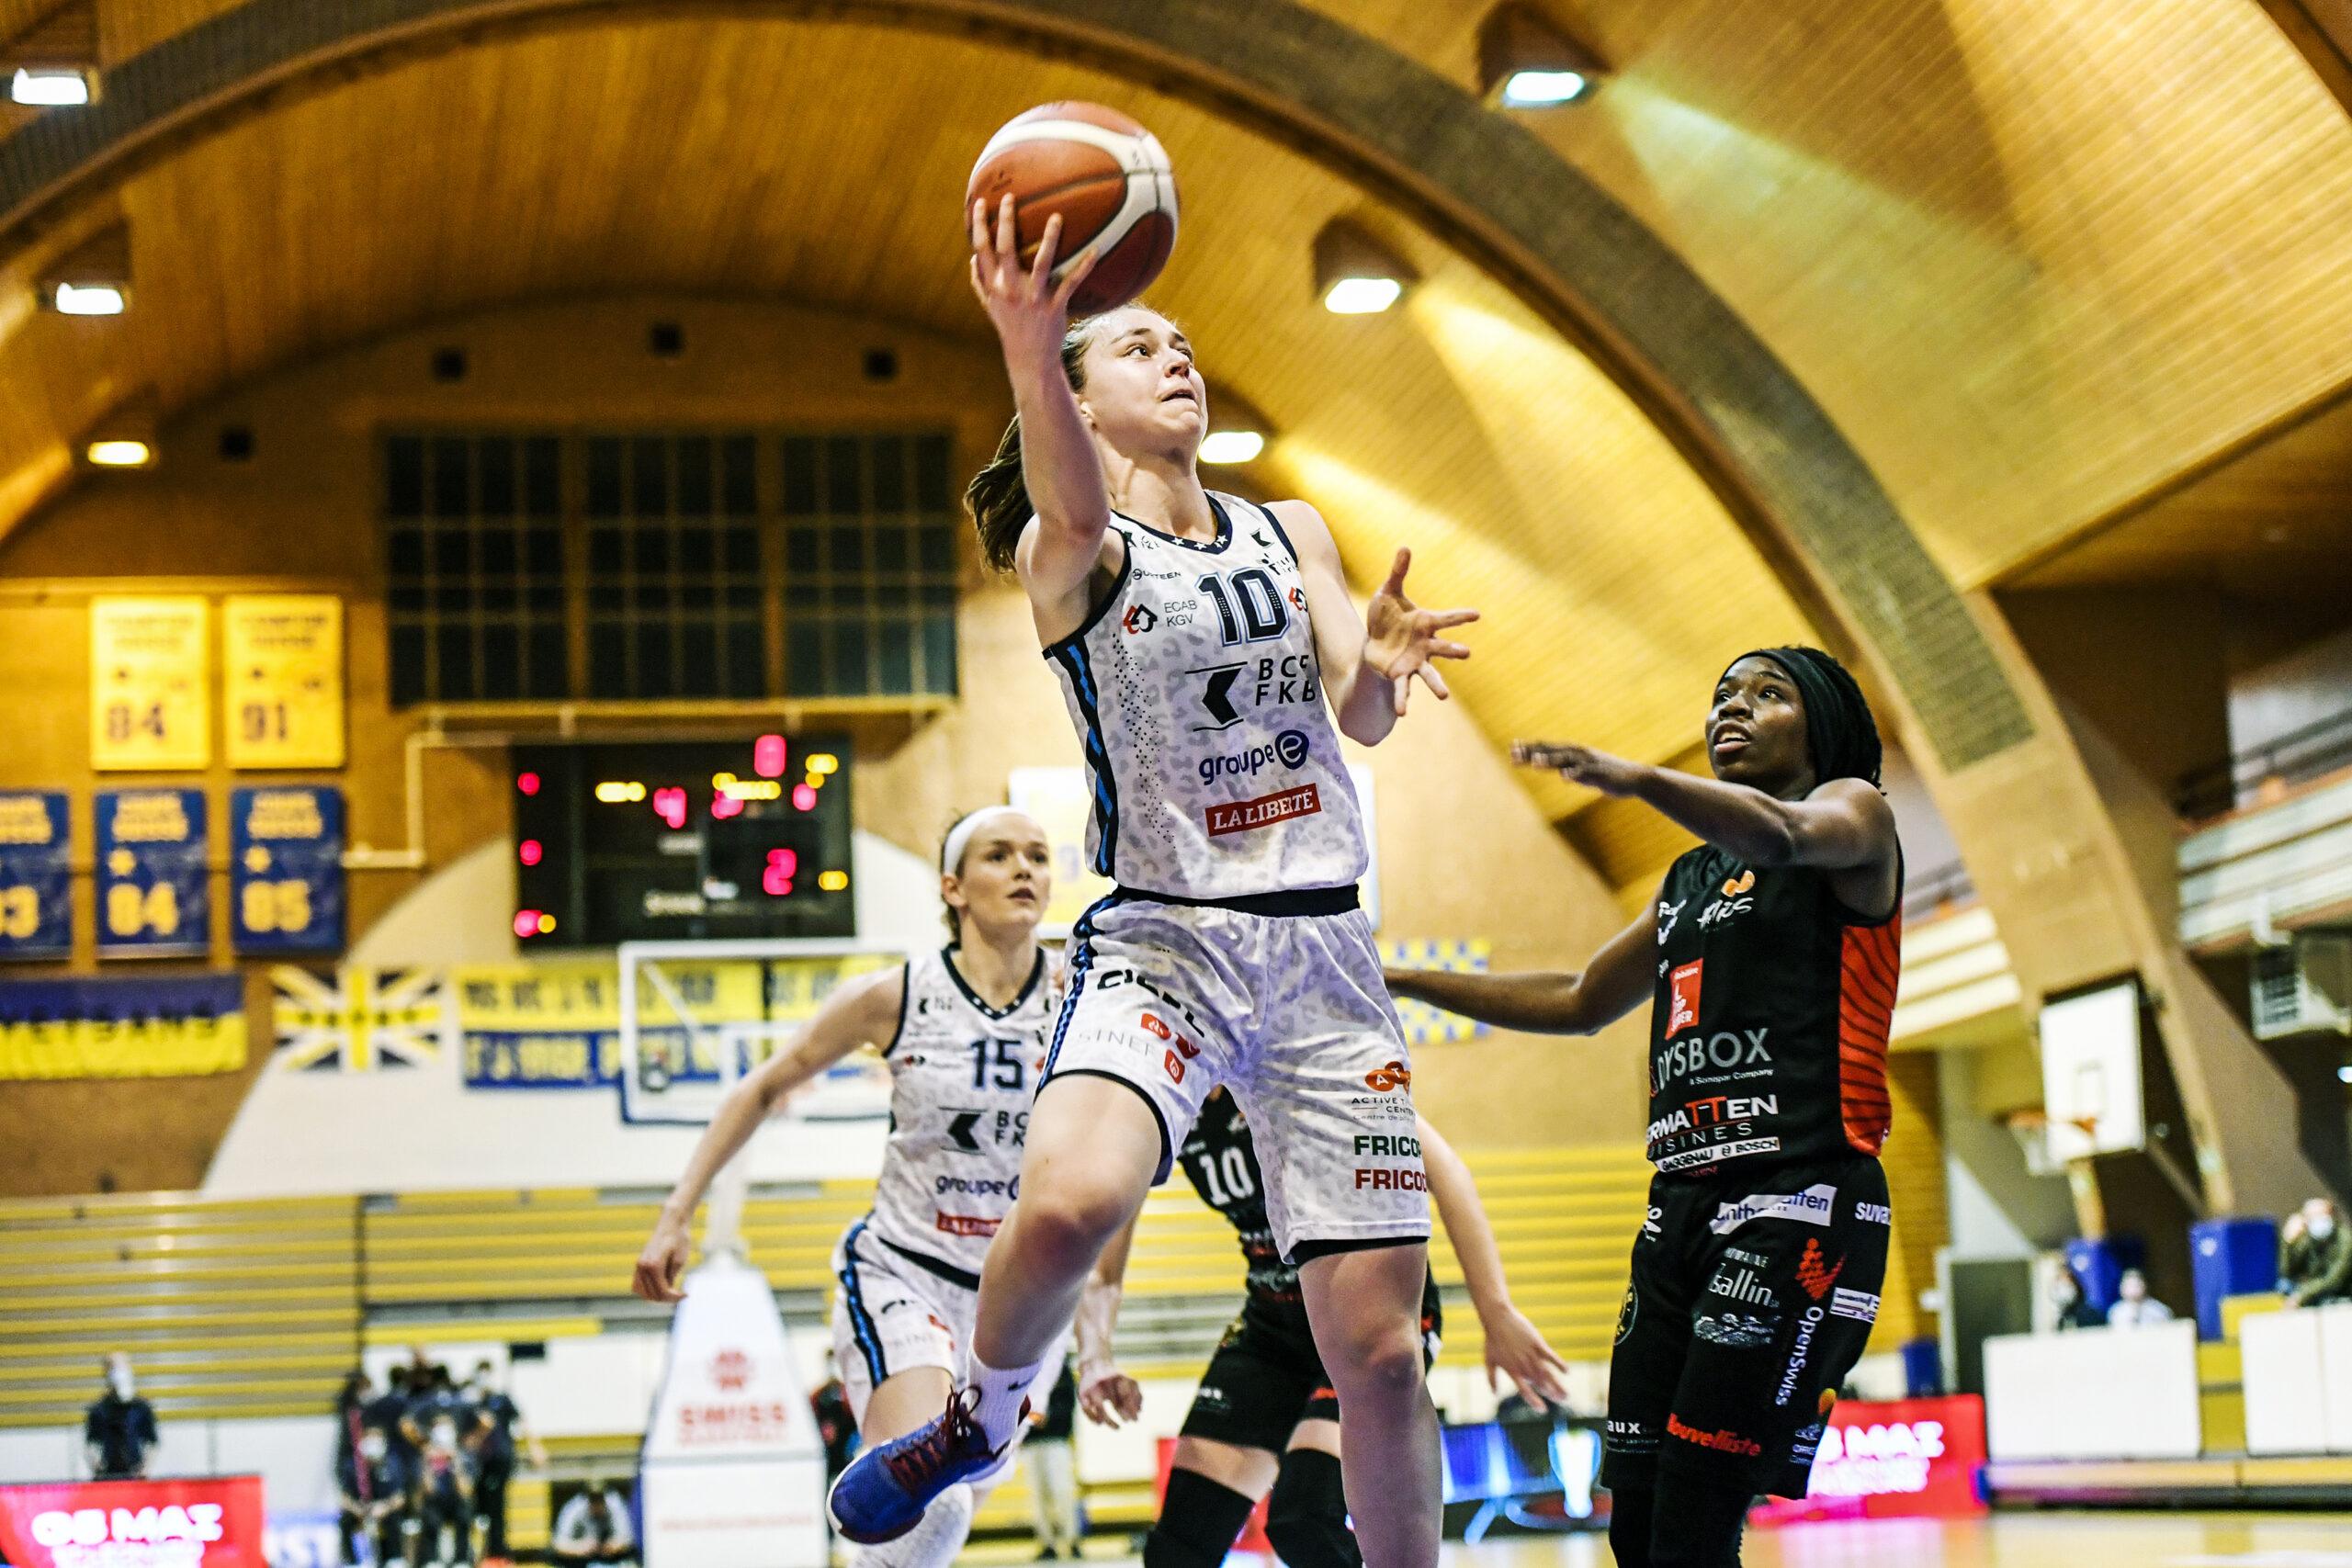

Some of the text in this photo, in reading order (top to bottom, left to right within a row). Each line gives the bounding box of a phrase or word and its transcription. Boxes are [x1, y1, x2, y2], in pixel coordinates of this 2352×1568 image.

[1164, 600, 1197, 614] ECAB
[1167, 614, 1193, 627] KGV
[1196, 567, 1290, 647] 10
[1255, 680, 1317, 706] FKB
[1198, 744, 1275, 786] groupe
[1214, 809, 1243, 830] LA
[970, 1038, 1024, 1090] 15
[1657, 1027, 1772, 1090] DYSBOX
[1736, 1139, 1778, 1154] BOSCH
[935, 1174, 1004, 1198] groupe
[1199, 1147, 1255, 1206] 10
[1775, 1305, 1824, 1406] OpenSwiss
